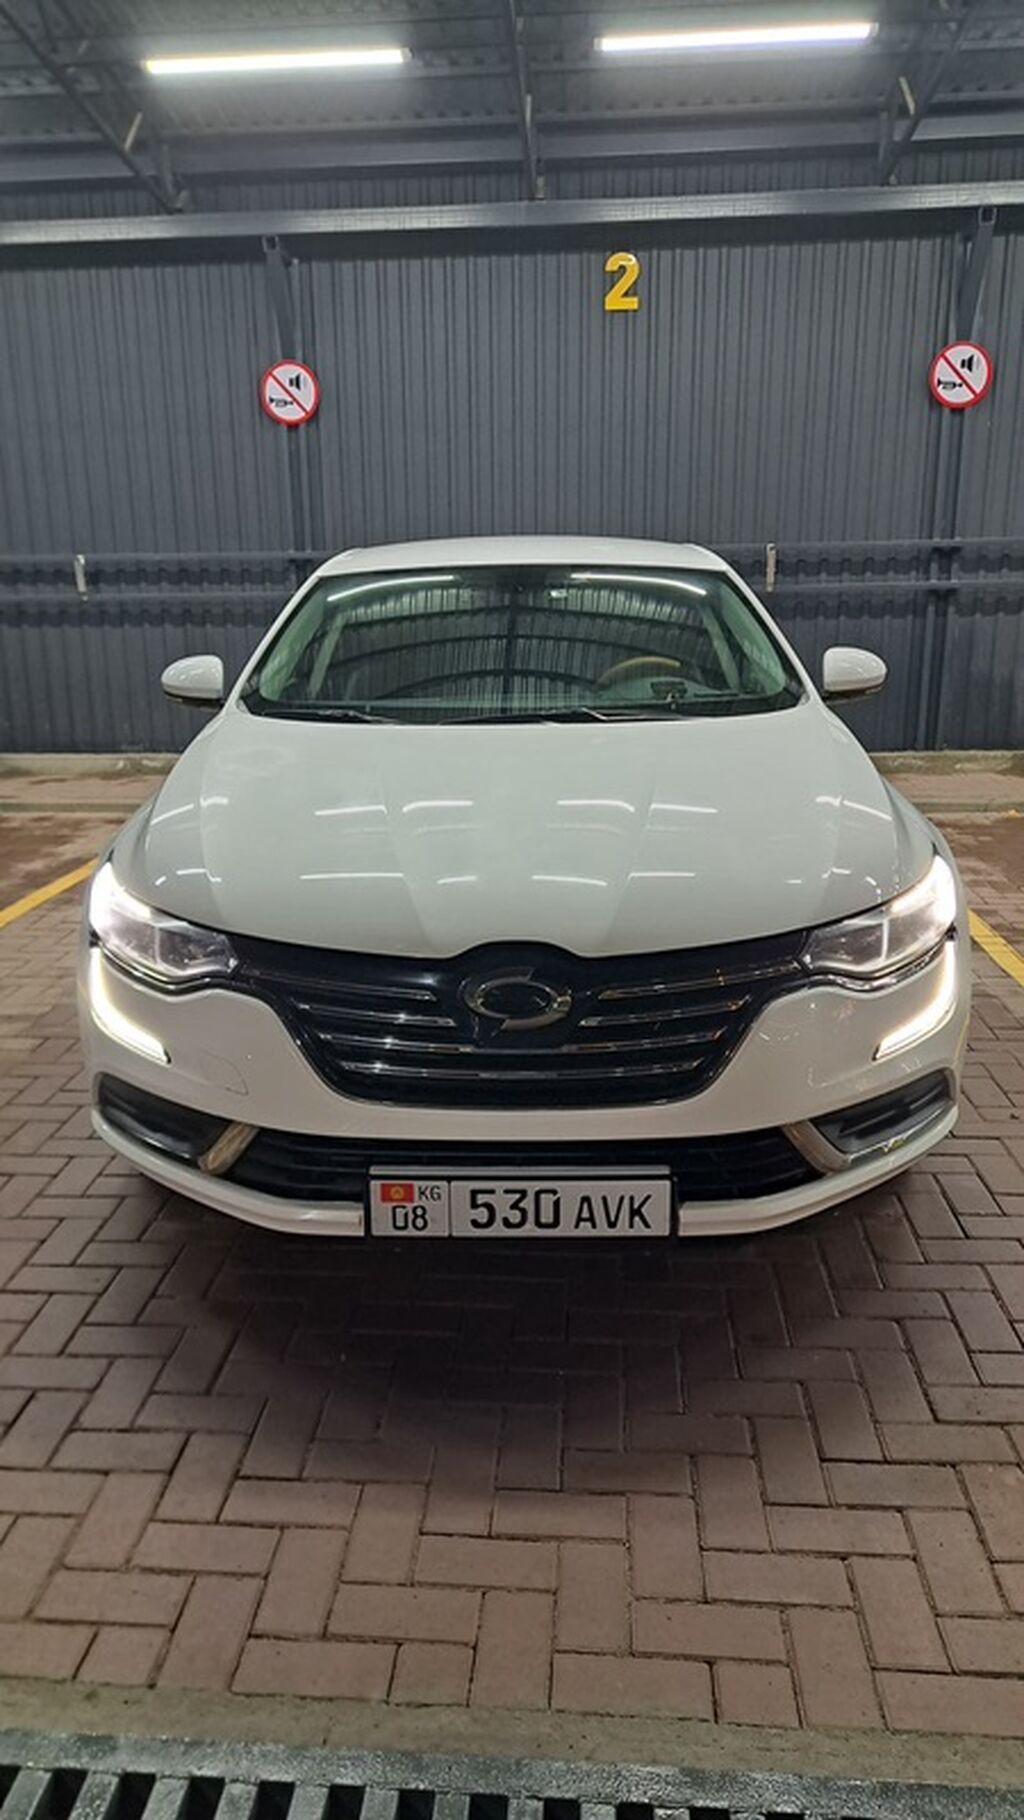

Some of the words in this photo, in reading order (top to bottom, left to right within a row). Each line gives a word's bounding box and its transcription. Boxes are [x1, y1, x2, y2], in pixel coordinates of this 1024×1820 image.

[605, 252, 639, 310] 2
[418, 1186, 441, 1201] KG
[470, 1189, 561, 1230] 530
[574, 1195, 652, 1230] AVK
[392, 1205, 428, 1231] 08
